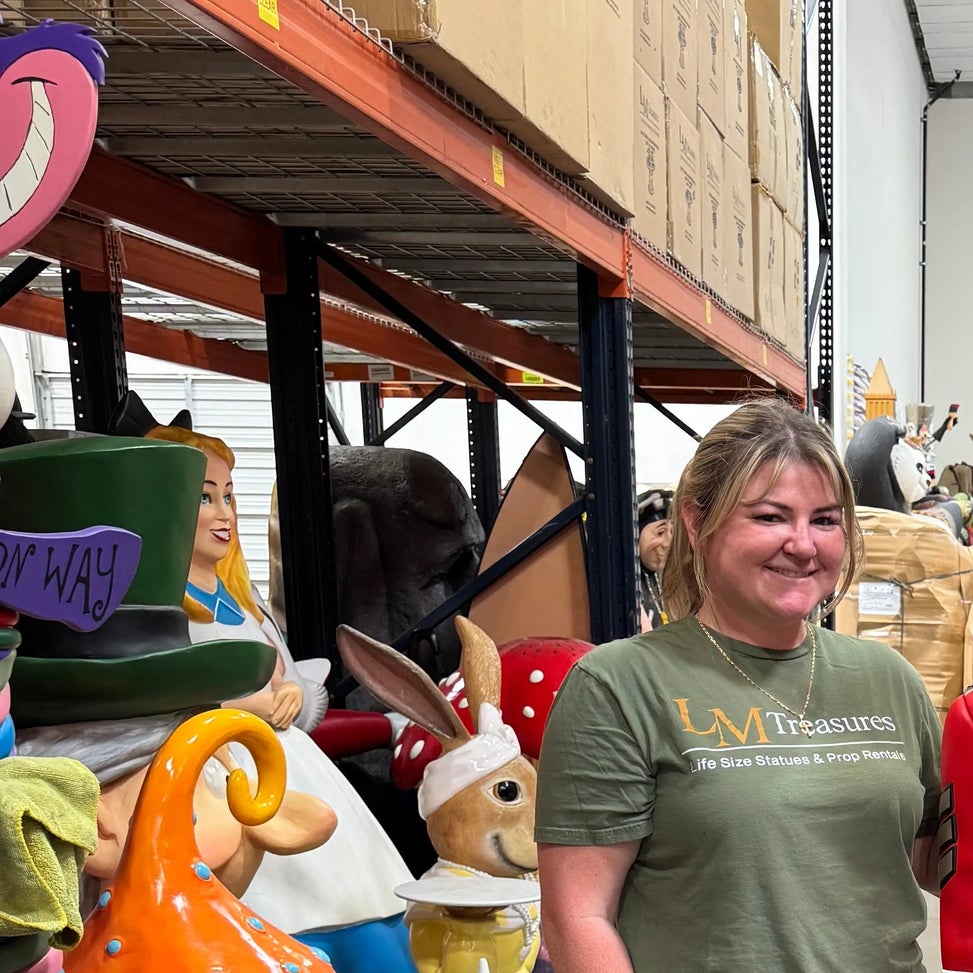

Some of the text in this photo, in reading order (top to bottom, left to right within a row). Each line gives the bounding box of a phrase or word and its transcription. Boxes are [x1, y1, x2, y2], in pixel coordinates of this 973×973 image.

[43, 543, 119, 622] WAY
[672, 698, 896, 747] LM Treasures
[690, 749, 906, 774] Life Size Statues & Prop Rentals
